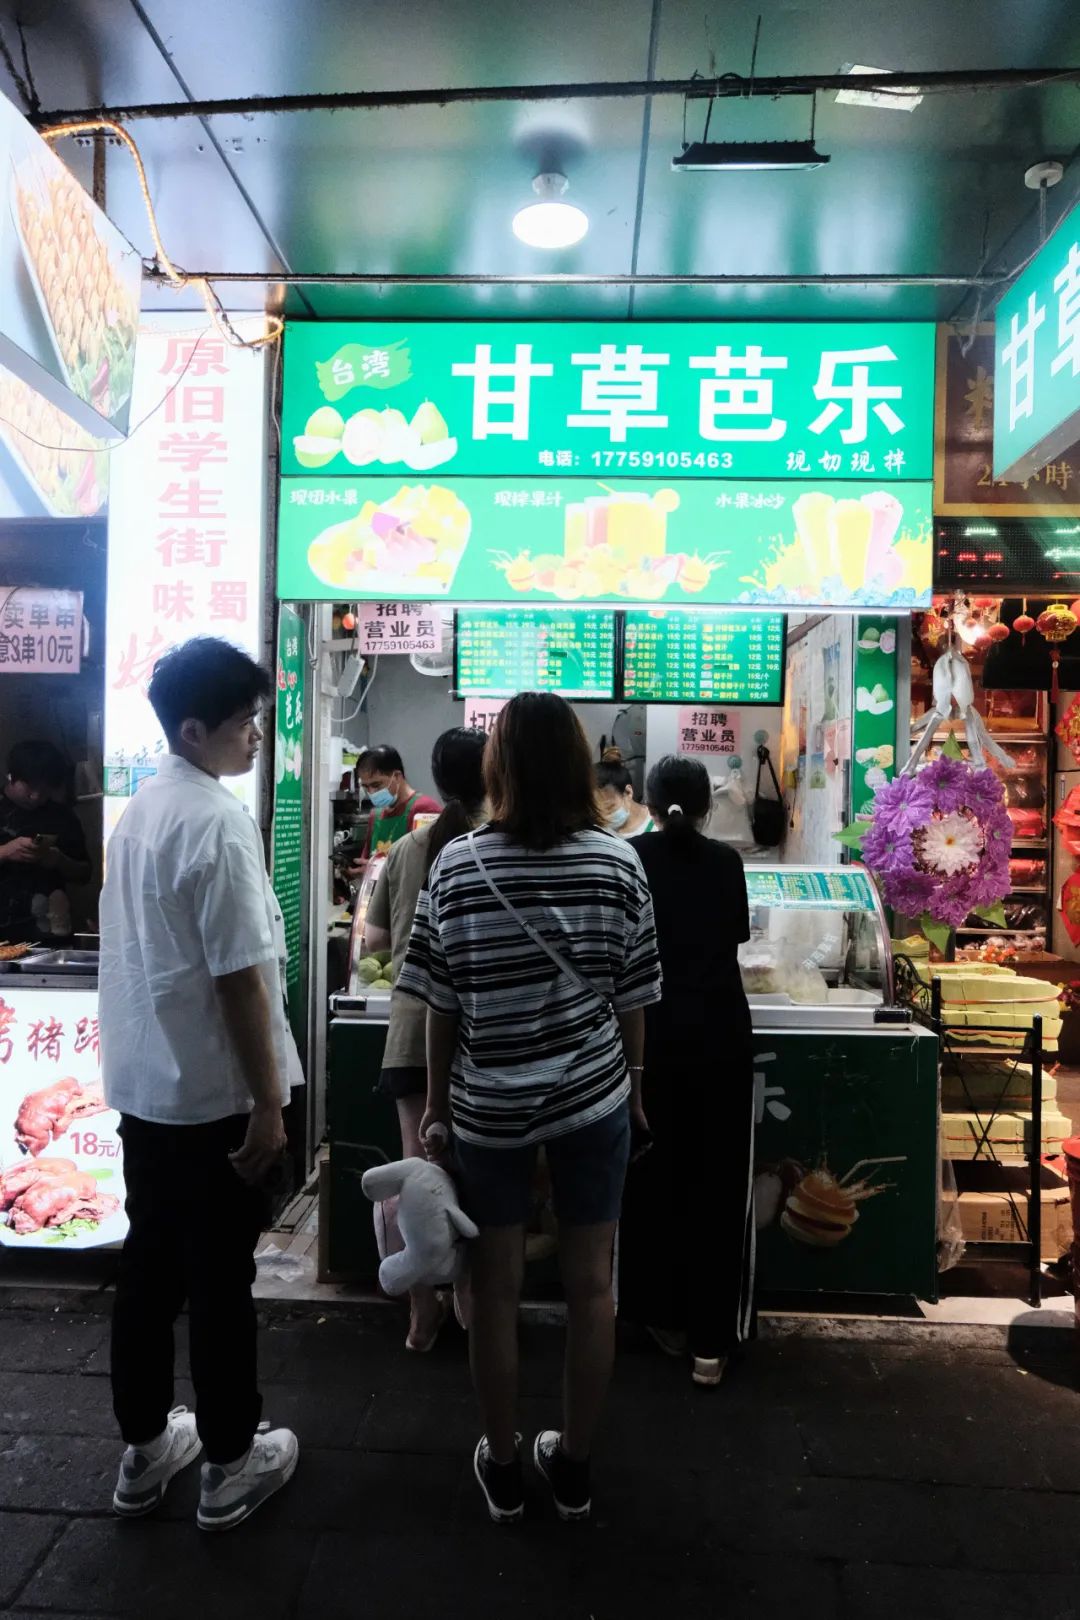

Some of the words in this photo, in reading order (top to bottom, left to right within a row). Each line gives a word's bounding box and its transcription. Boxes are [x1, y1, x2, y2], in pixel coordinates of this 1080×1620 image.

[332, 349, 390, 385] 台湾
[451, 344, 906, 444] 甘草芭乐
[156, 338, 230, 568] 原旧学生街
[591, 450, 733, 468] 17759105463
[786, 448, 906, 475] 现切现拌
[289, 488, 359, 505] 现切水果
[715, 492, 785, 509] 水果冰沙
[376, 603, 424, 617] 招聘
[364, 621, 436, 638] 营业员
[365, 640, 435, 651] 17759105463
[691, 711, 728, 728] 招聘
[681, 728, 736, 744] 营业员
[681, 743, 736, 753] 17759105463
